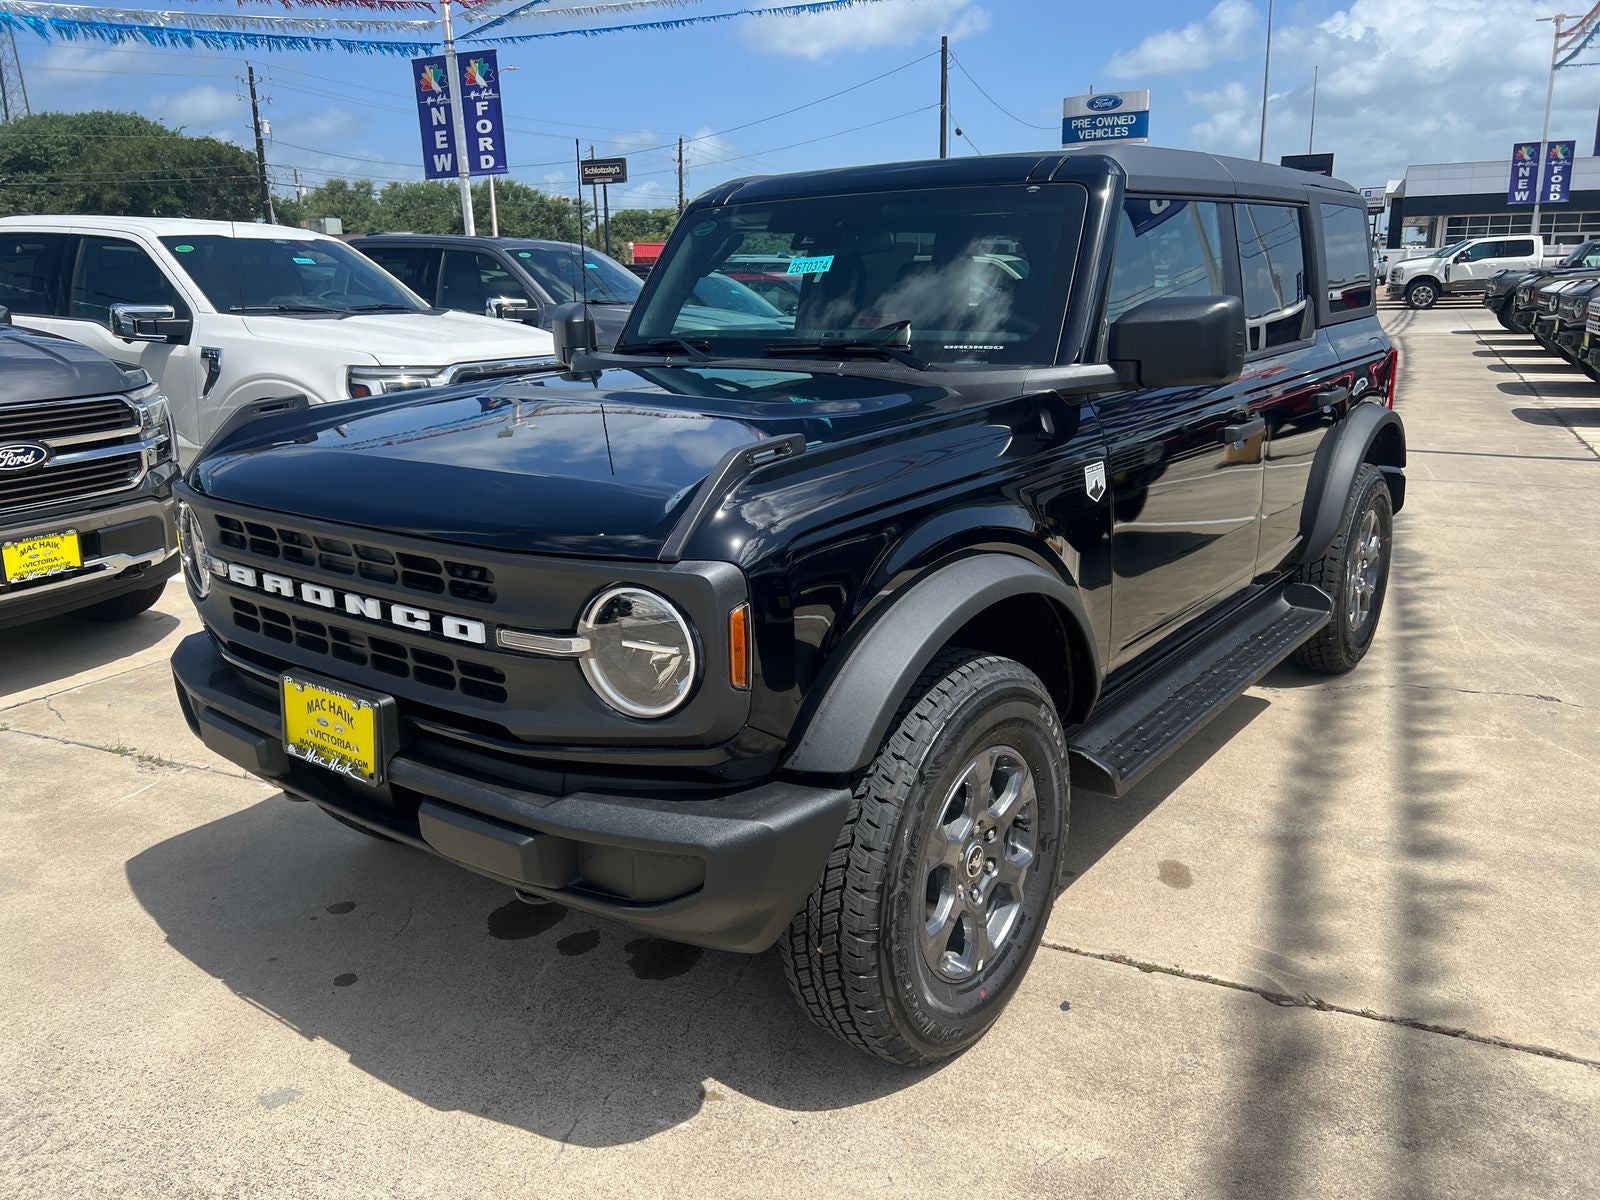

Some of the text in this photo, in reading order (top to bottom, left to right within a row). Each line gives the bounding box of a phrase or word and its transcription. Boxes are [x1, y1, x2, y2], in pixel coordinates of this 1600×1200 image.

[1093, 98, 1114, 109] Ford
[1071, 115, 1136, 129] PRE-OWNED
[1078, 126, 1129, 140] VEHICLES
[430, 107, 453, 172] NEW
[475, 101, 496, 169] FORD
[1514, 166, 1531, 201] NEW
[1549, 165, 1563, 200] FORD
[790, 259, 830, 273] 26T0374
[0, 448, 35, 467] Ford
[20, 541, 60, 557] MAC HAIK
[25, 556, 58, 568] VICTORIA
[228, 563, 487, 644] BRONCO
[306, 698, 355, 730] MAC HAIK
[312, 728, 352, 751] VICTORIA
[304, 747, 354, 774] Mac Haik
